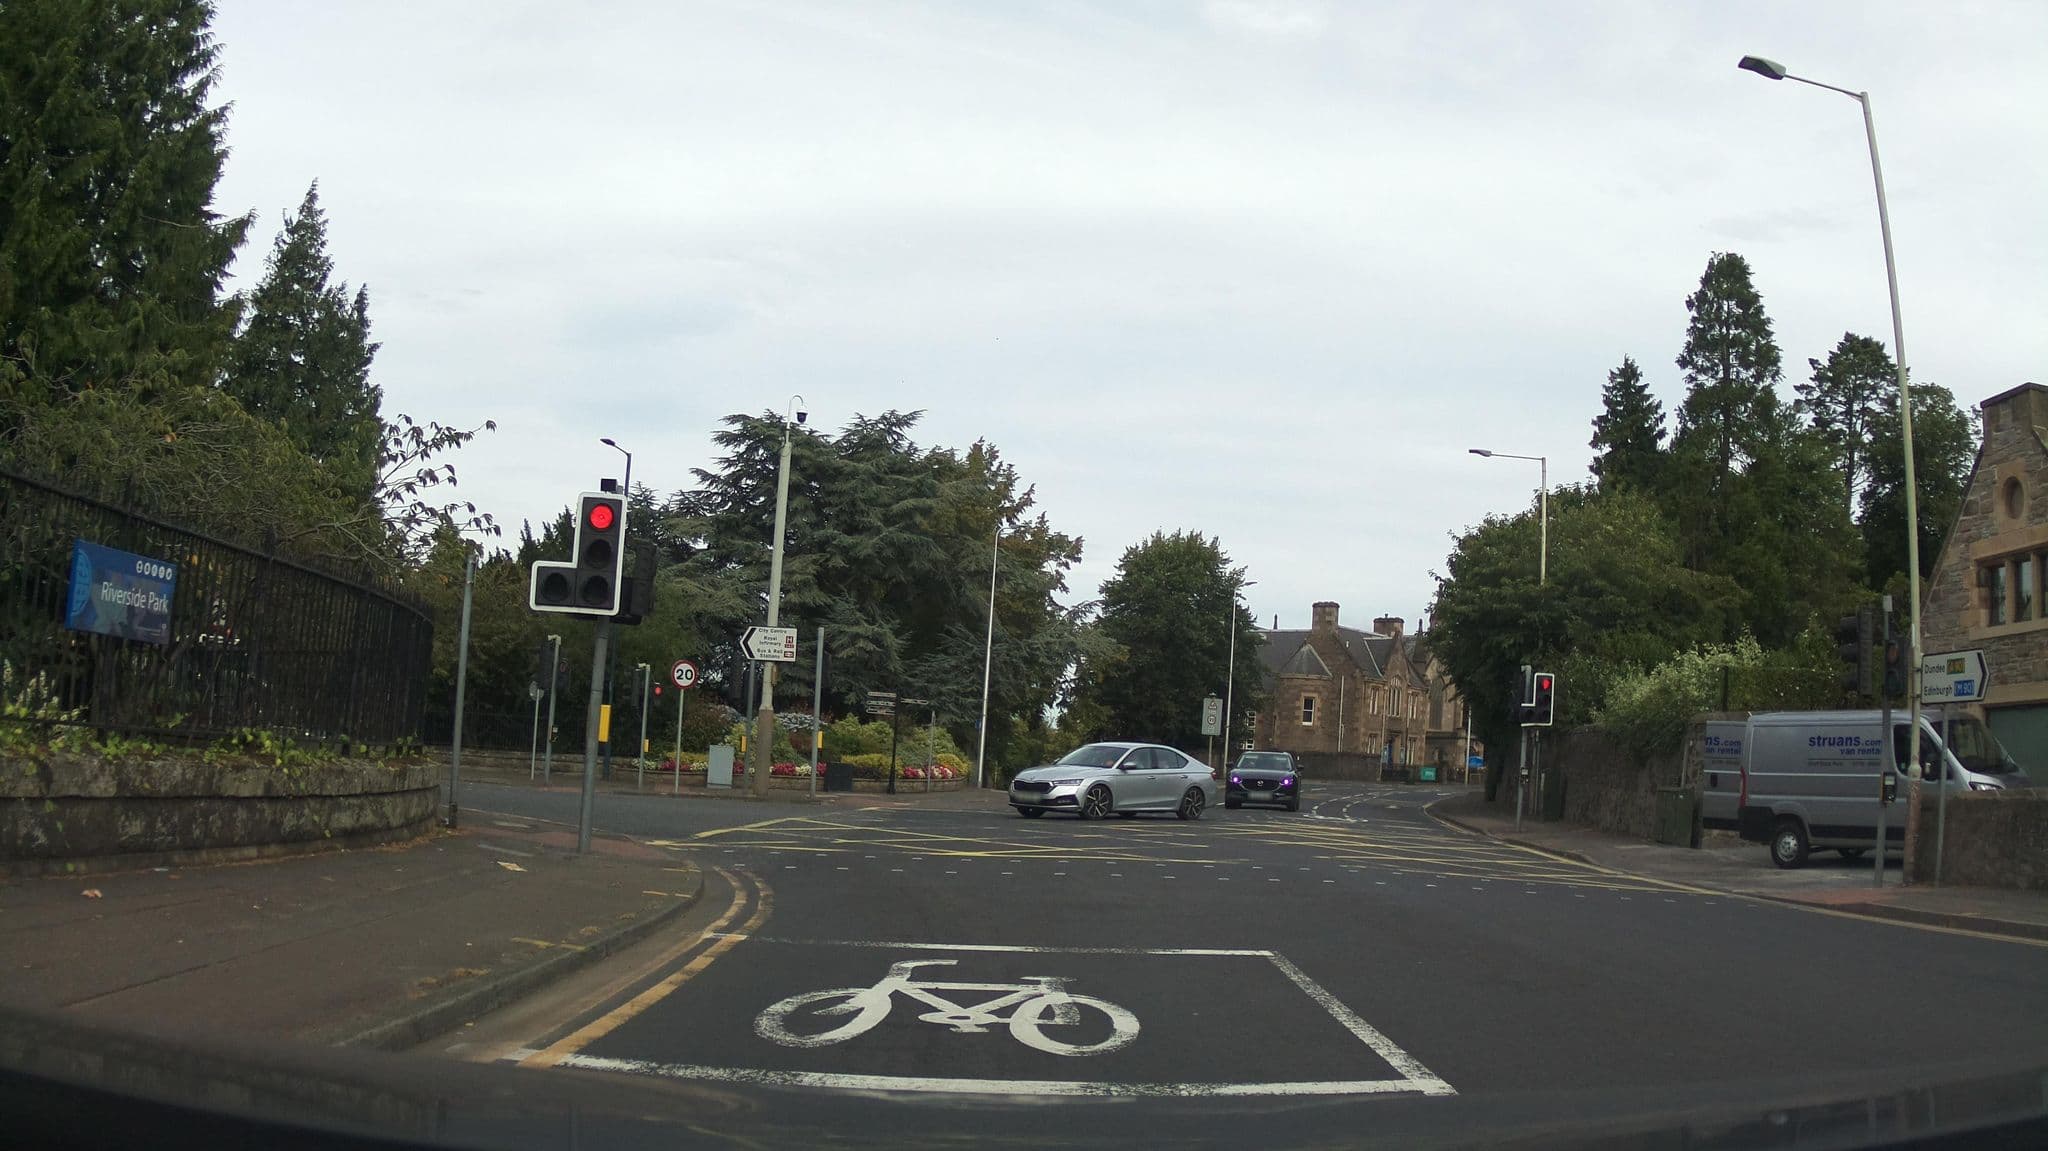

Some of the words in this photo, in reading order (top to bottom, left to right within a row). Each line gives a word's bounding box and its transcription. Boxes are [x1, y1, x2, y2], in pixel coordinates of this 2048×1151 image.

[101, 582, 146, 609] Riverside
[147, 592, 169, 615] Park
[676, 668, 694, 680] 20
[1924, 664, 1945, 674] Dundee
[1923, 685, 1953, 697] Edinburgh
[1840, 747, 1856, 755] van
